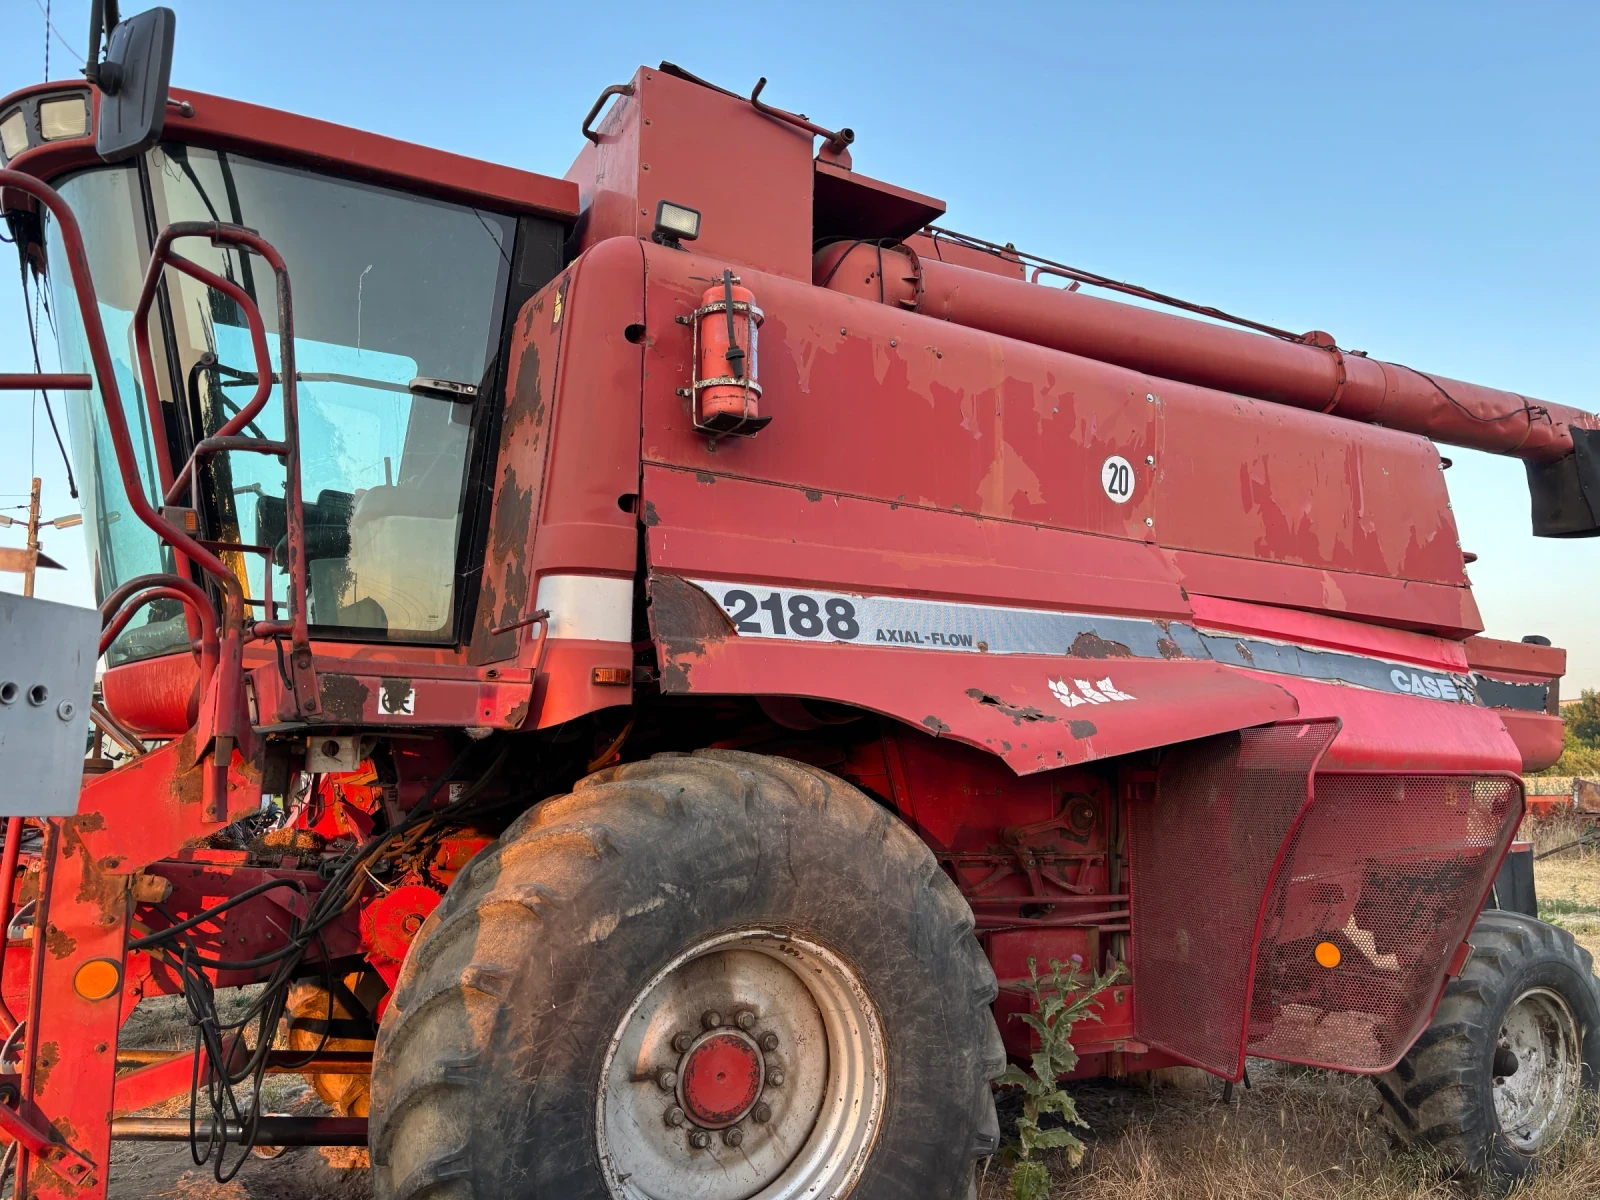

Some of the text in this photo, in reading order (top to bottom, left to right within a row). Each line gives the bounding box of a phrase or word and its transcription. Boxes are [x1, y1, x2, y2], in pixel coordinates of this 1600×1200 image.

[1108, 462, 1129, 497] 20
[723, 589, 860, 640] 2188
[875, 628, 973, 647] AXIAL-FLOW
[1390, 669, 1459, 700] CASE
